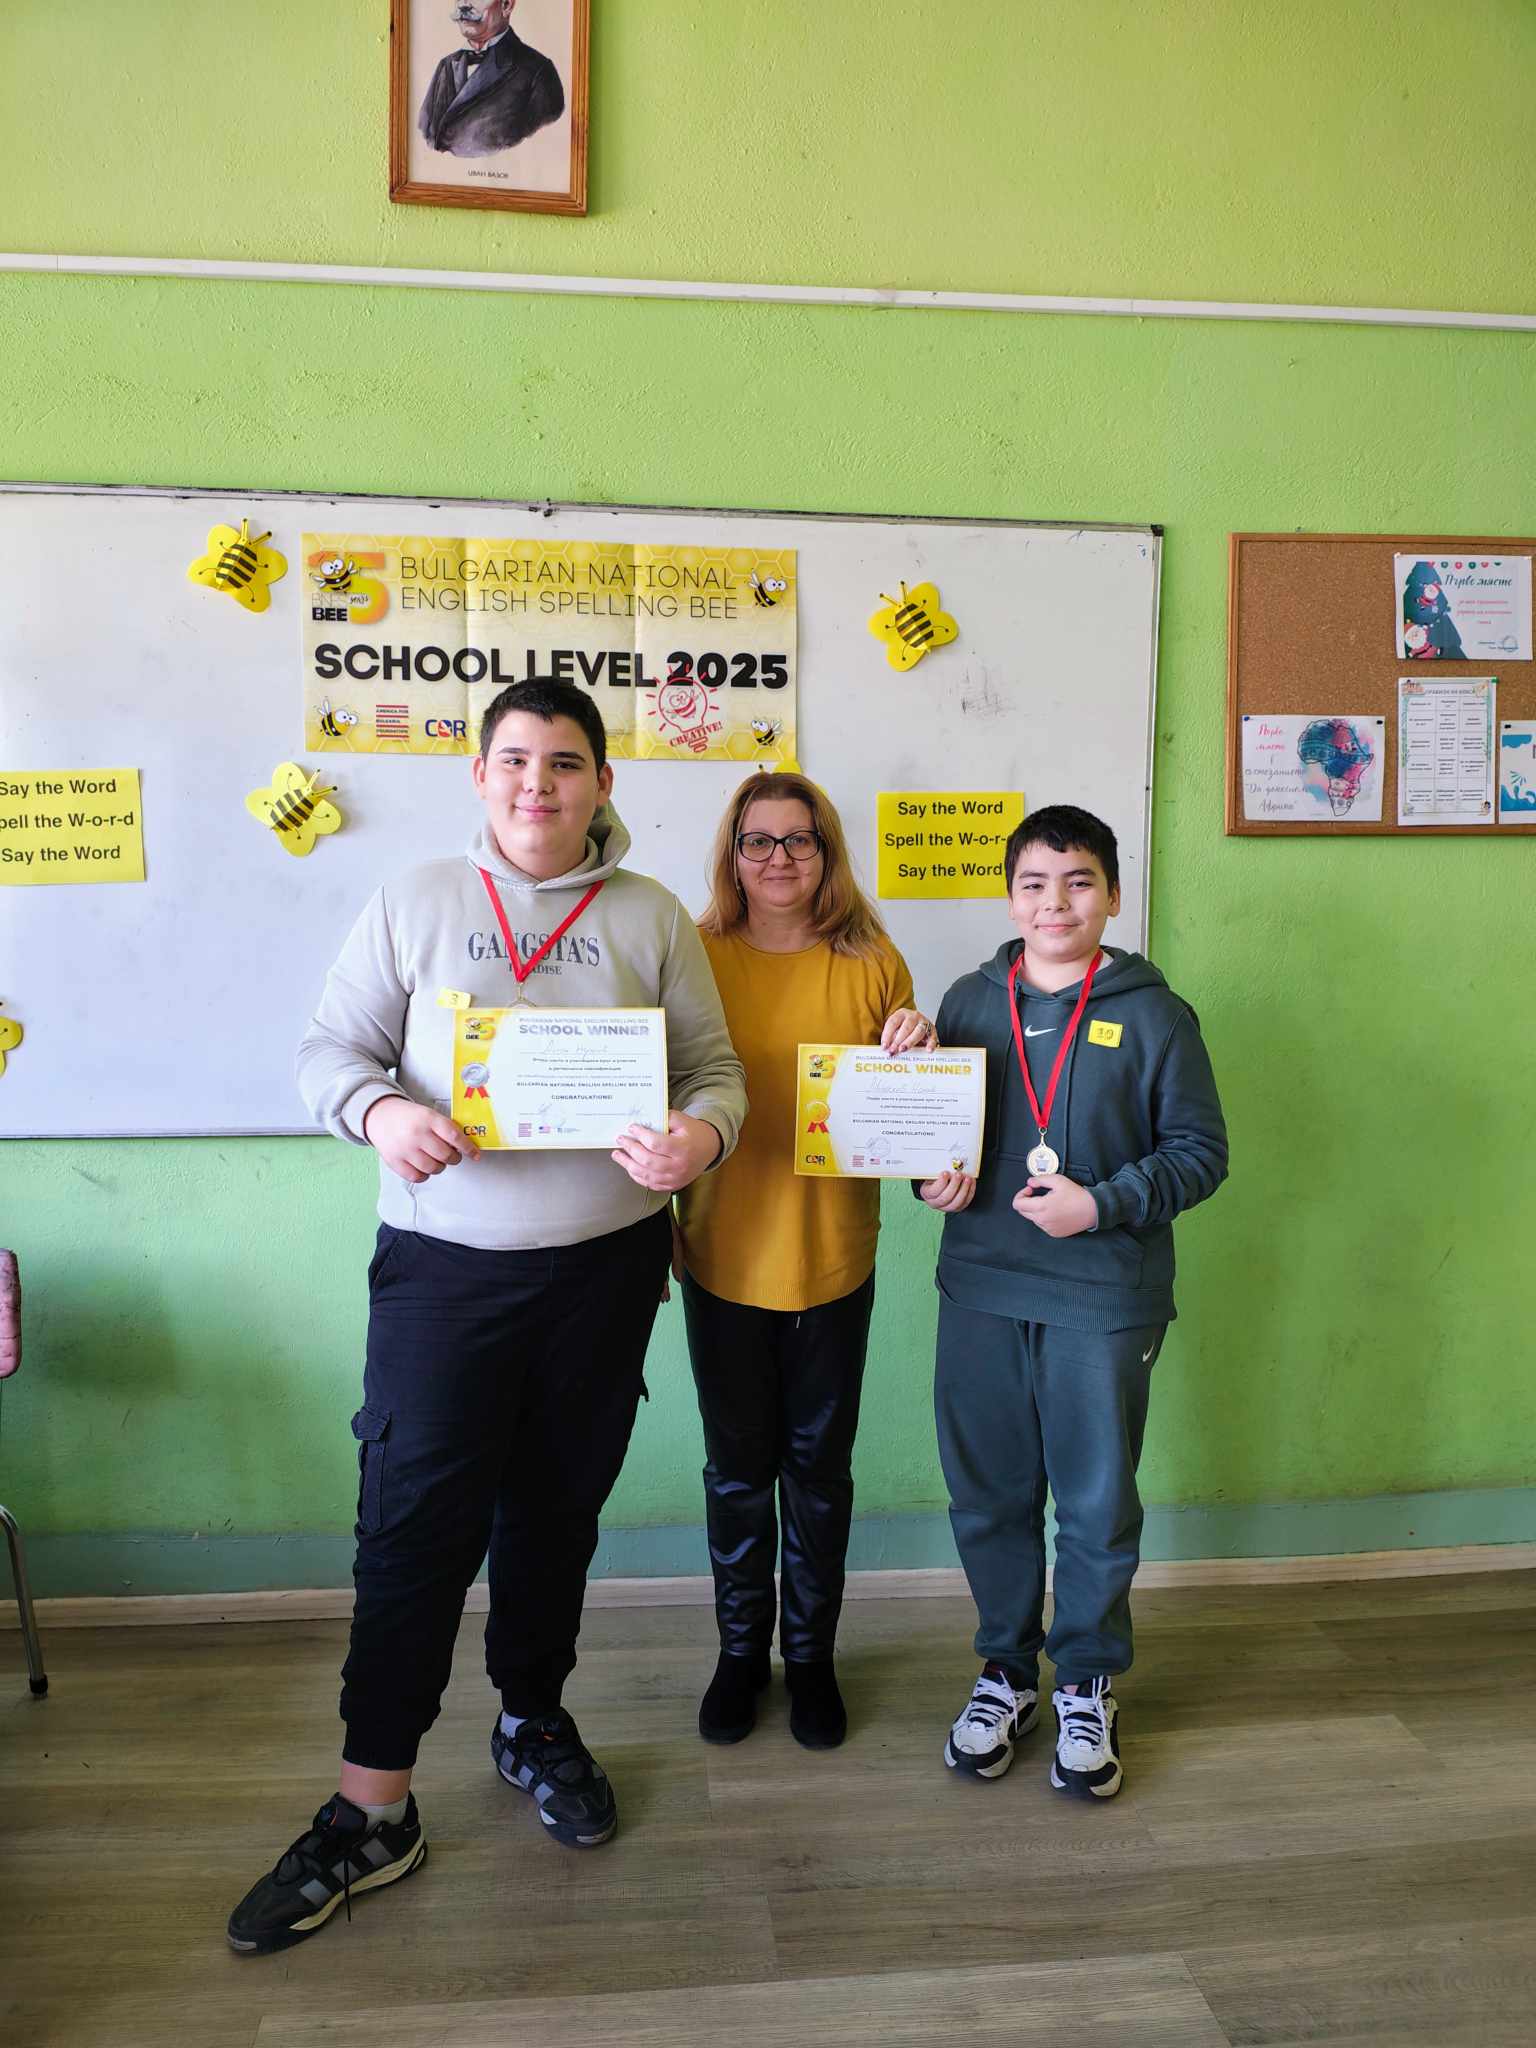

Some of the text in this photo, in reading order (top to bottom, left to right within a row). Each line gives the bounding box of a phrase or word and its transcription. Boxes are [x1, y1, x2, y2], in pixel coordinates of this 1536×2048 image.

[401, 556, 737, 590] BULGARIAN NATIONAL
[401, 587, 737, 619] ENGLISH SPELLING BEE
[312, 607, 348, 621] BEE
[314, 643, 514, 684] SCHOOL
[666, 651, 788, 689] 2025
[0, 779, 117, 799] Say the Word
[897, 800, 1003, 818] Say the Word
[0, 811, 134, 832] pell the W-o-r-d
[884, 832, 1006, 850] Spell the W-o-r-
[2, 845, 120, 865] Say the Word
[898, 862, 1003, 880] Say the Word
[519, 1024, 649, 1036] SCHOOL WINNER
[855, 1062, 972, 1075] SCHOOL WINNER
